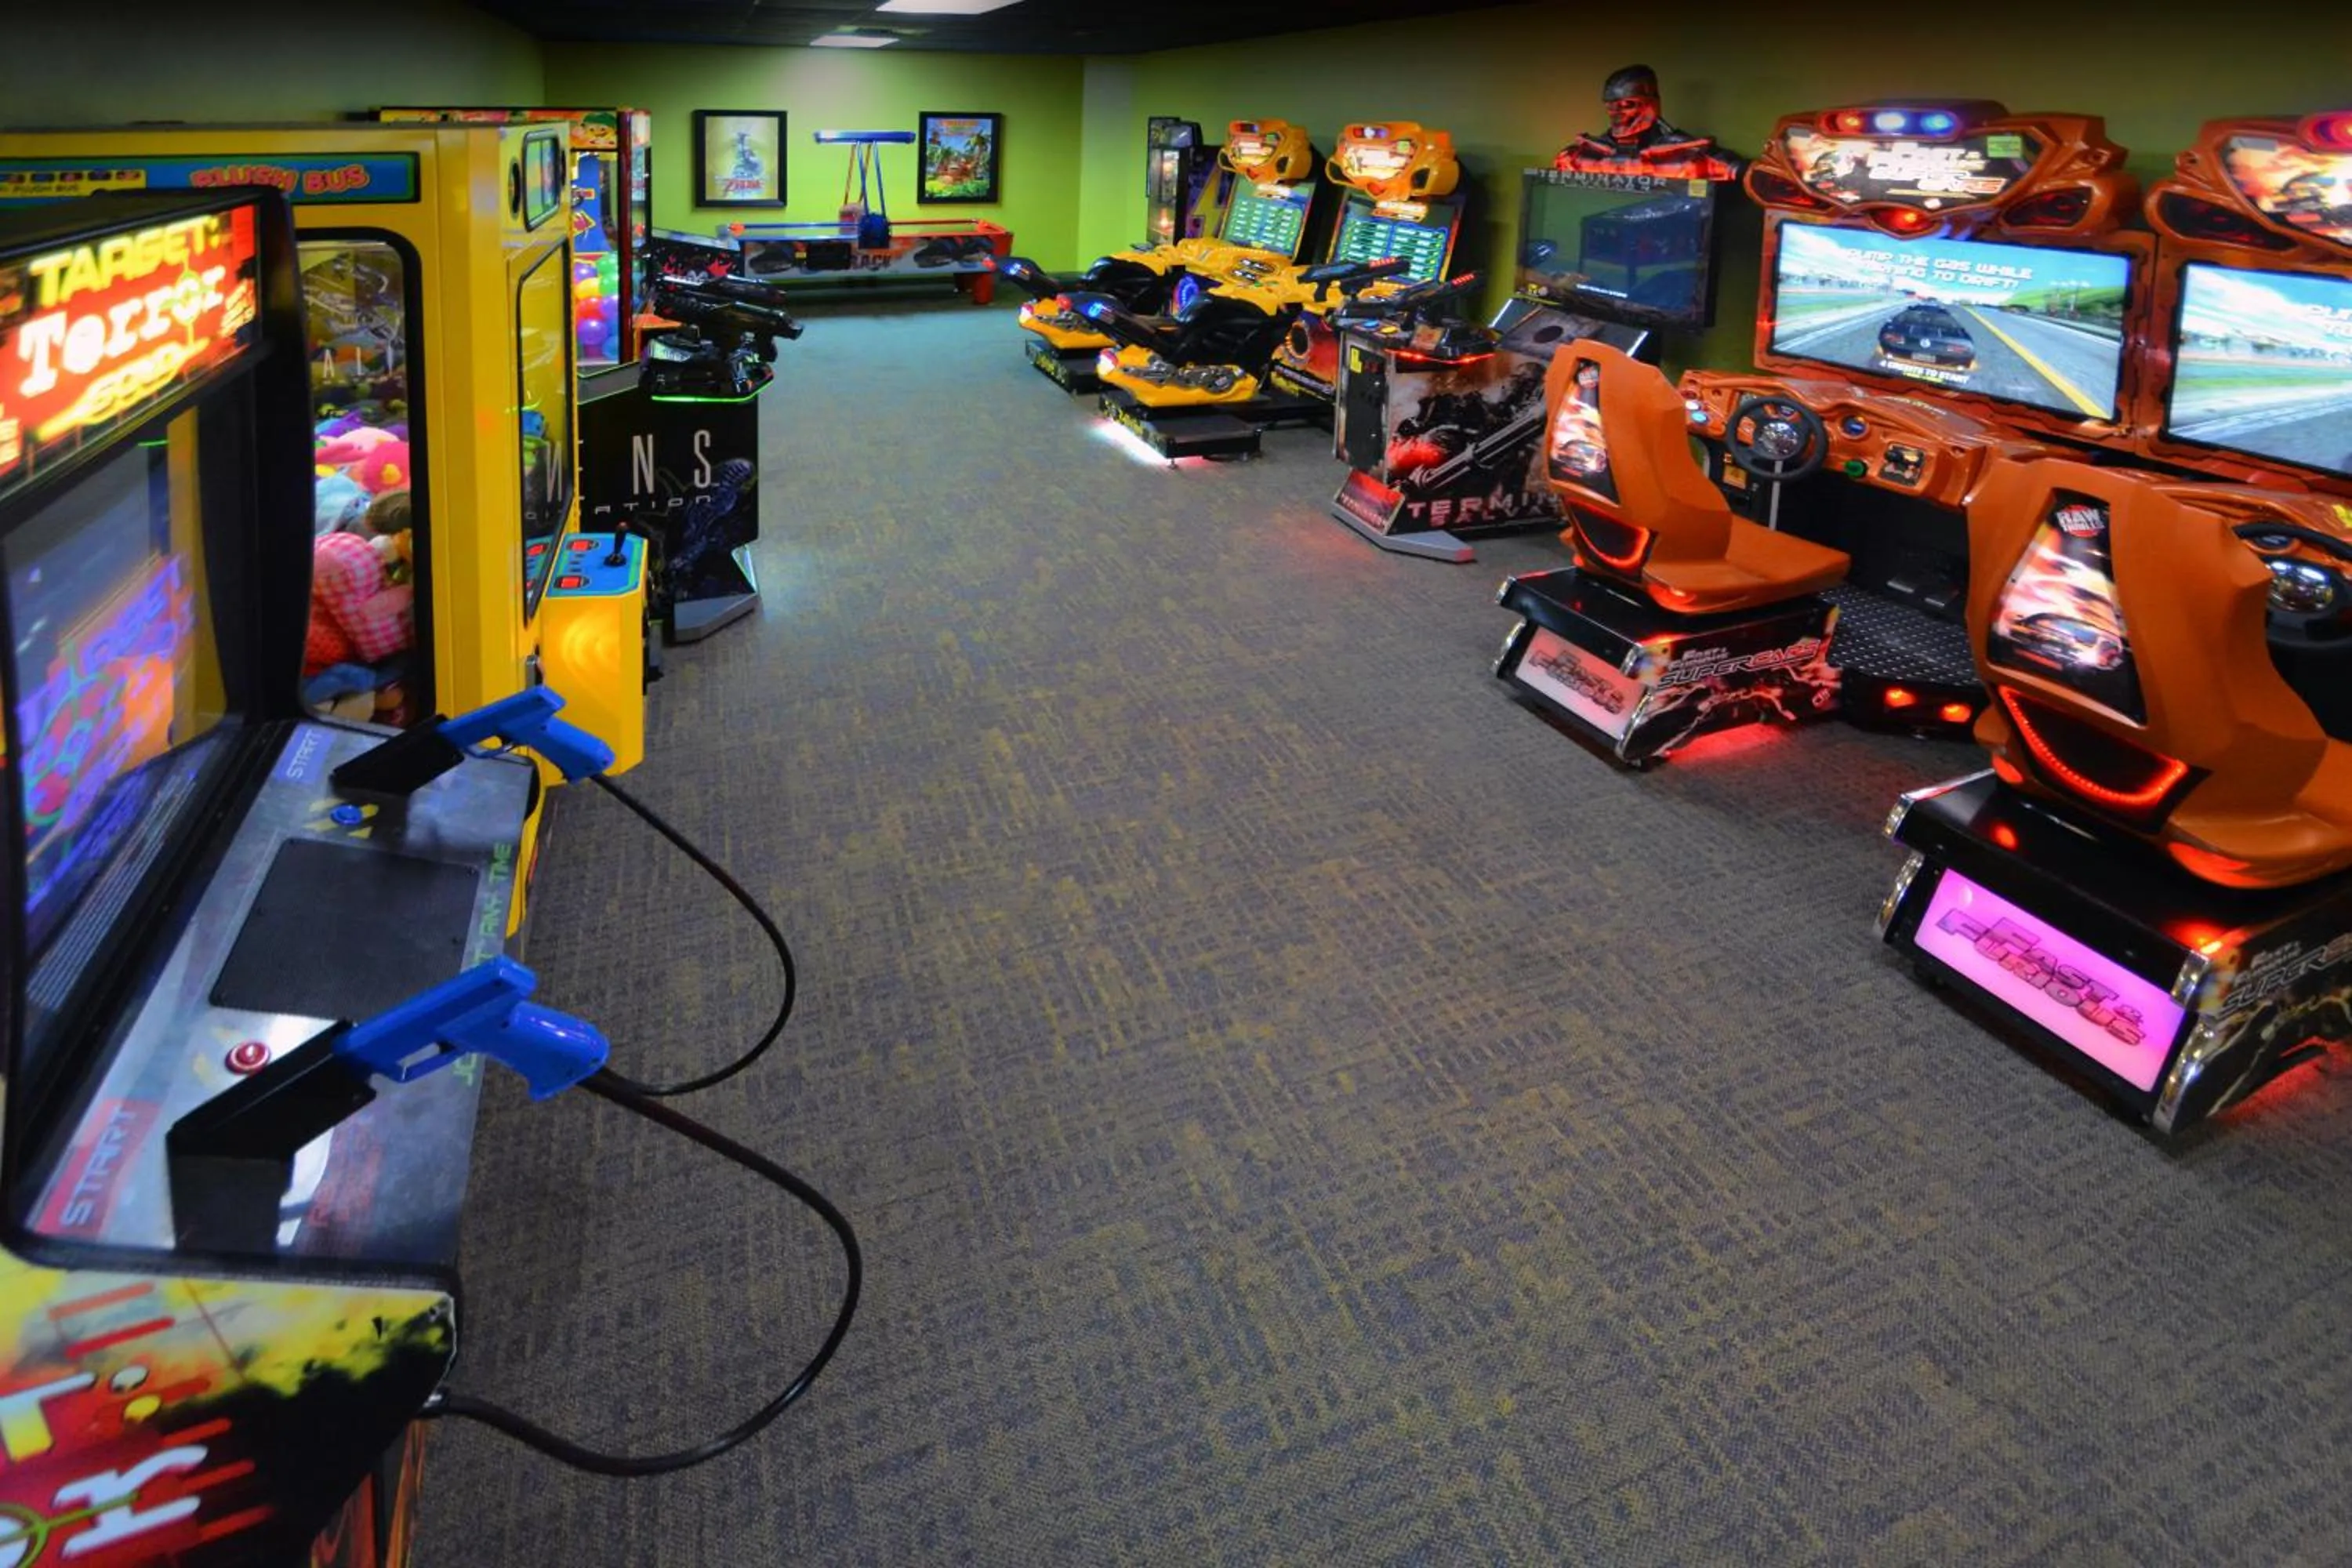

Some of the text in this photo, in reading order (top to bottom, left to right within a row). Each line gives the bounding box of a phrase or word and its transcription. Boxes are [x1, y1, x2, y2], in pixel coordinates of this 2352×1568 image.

[190, 164, 369, 194] PLUSH BUS
[1540, 169, 1668, 187] TERMINATOR
[1898, 252, 1929, 267] THE
[1933, 257, 1973, 273] GAS
[1975, 262, 2034, 280] WHILE
[1932, 269, 1955, 282] TO
[2056, 508, 2101, 527] RAW
[286, 728, 324, 779] START
[1987, 916, 2119, 1002] FAST
[1935, 907, 2147, 1047] FURIOUS
[61, 1105, 138, 1227] START
